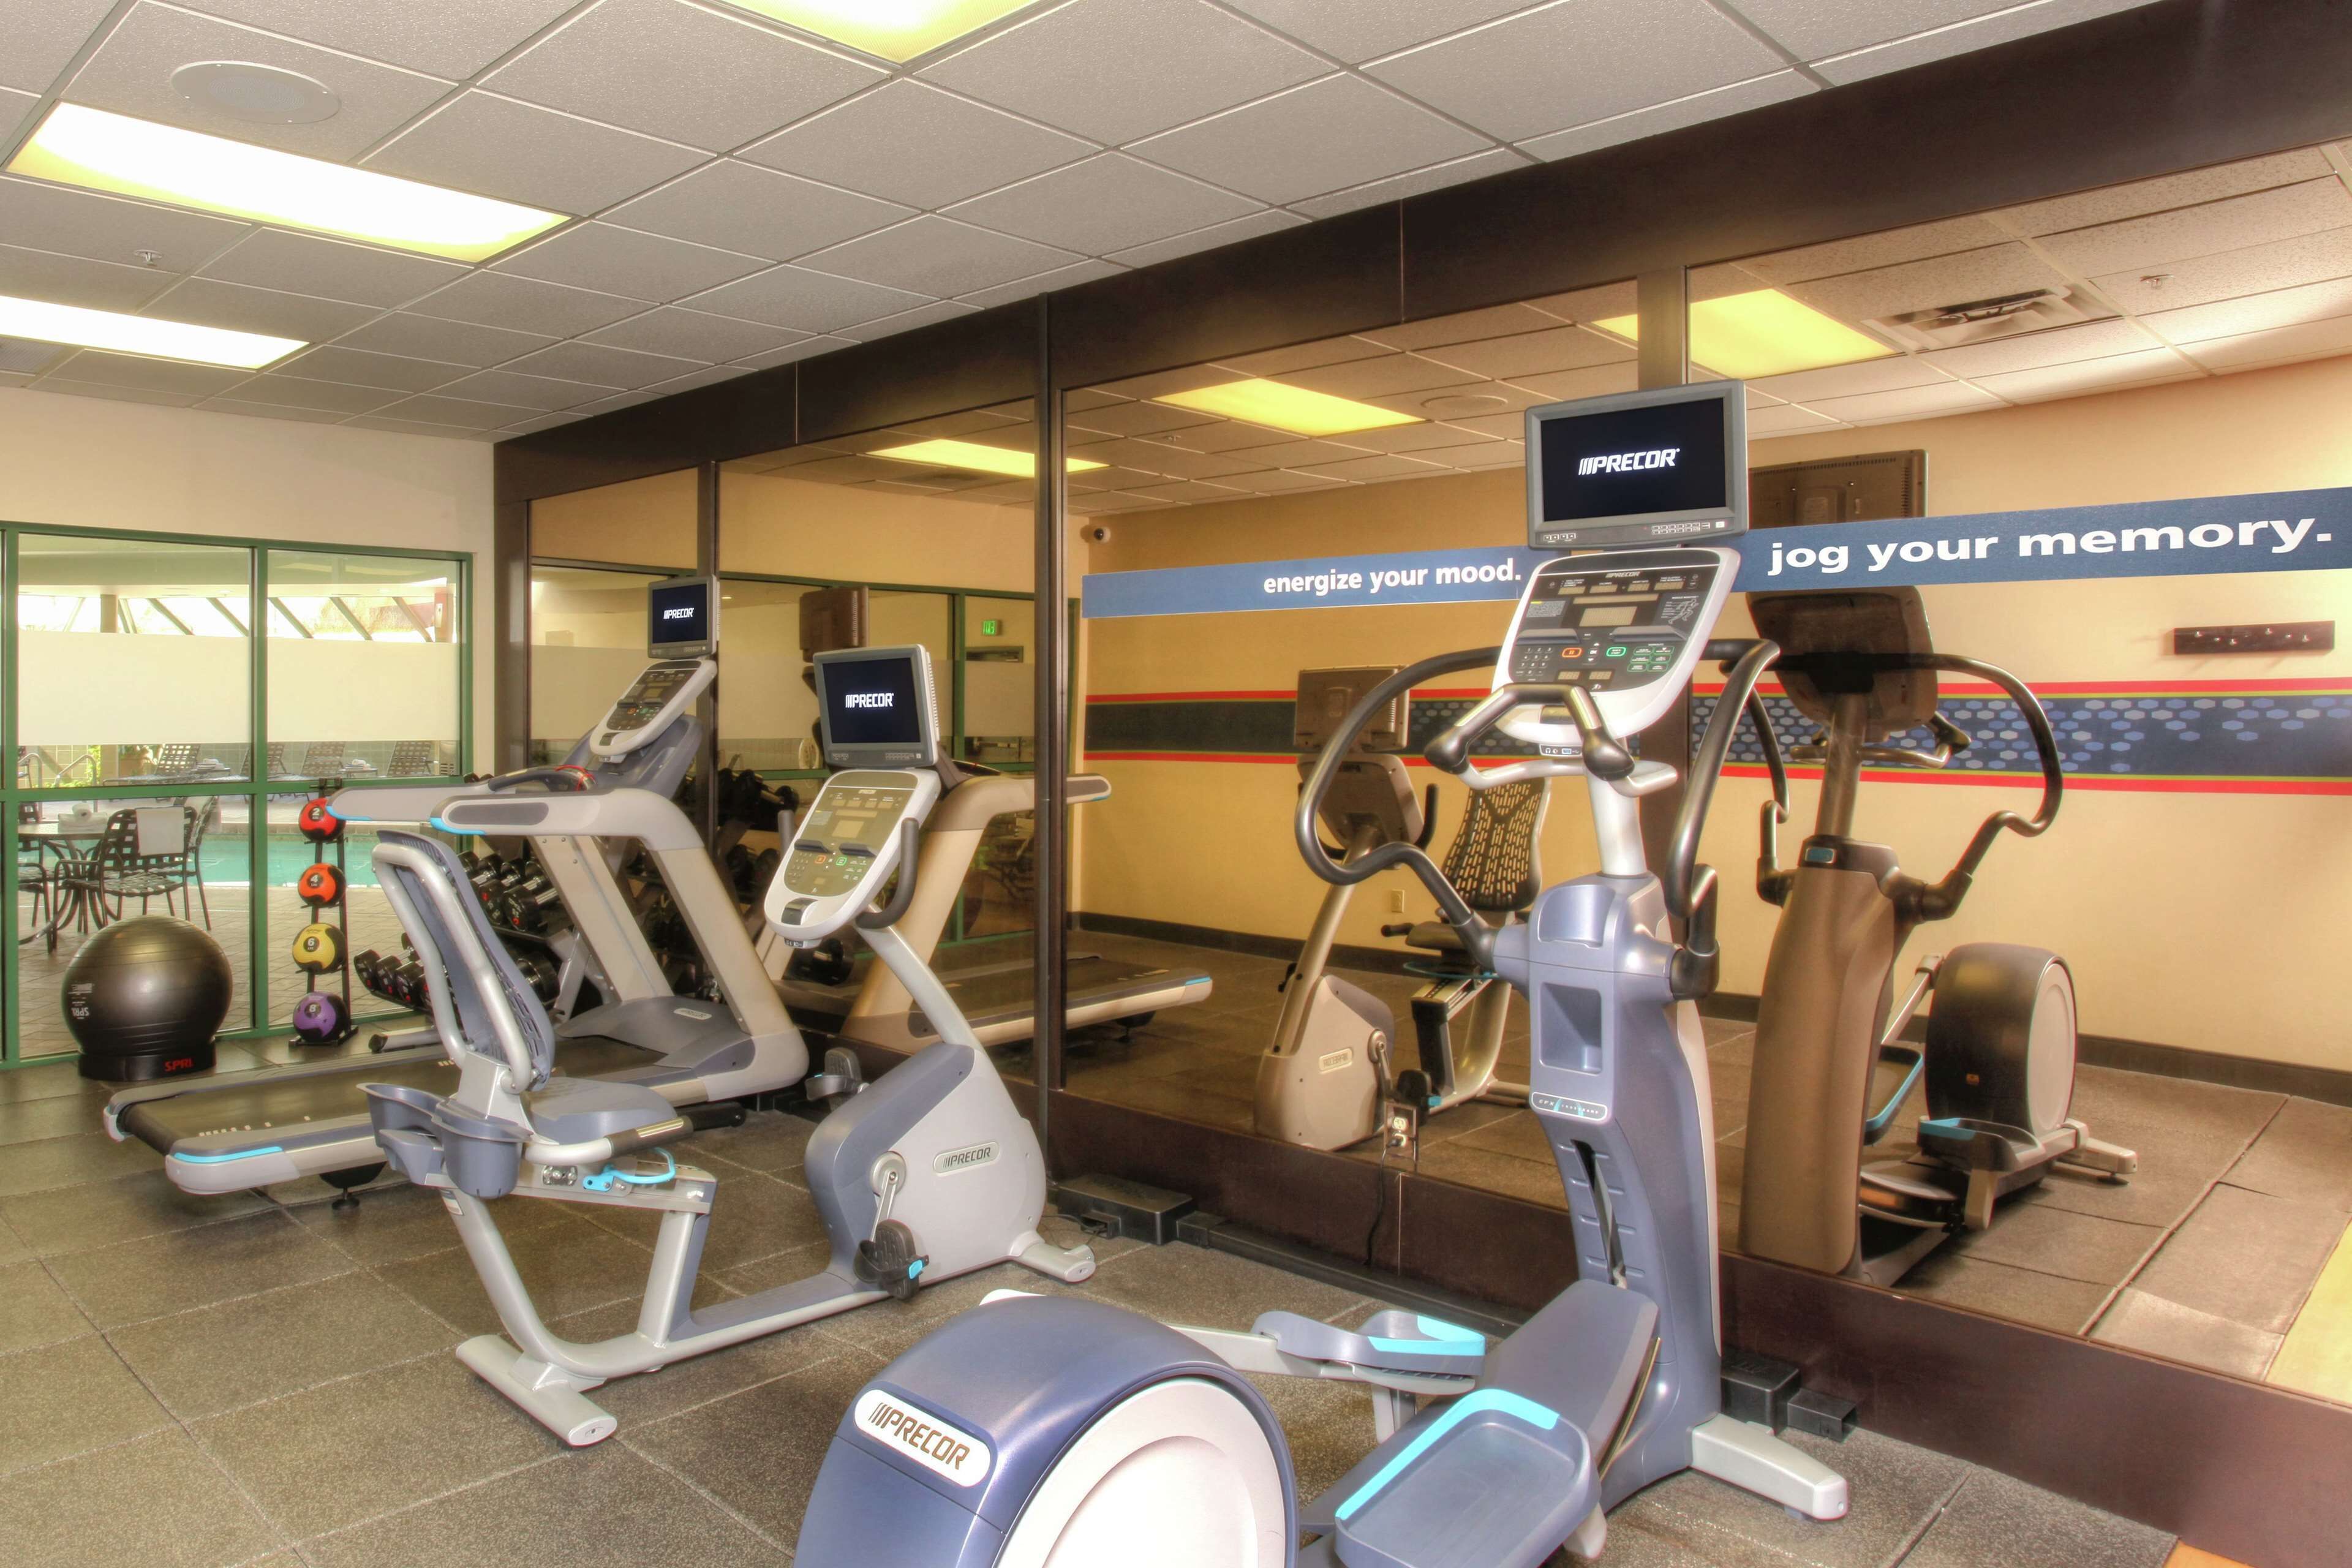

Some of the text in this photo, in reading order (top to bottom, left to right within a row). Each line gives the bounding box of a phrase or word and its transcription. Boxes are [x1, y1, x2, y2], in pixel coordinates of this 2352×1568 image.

[1591, 448, 1676, 475] PRECOR
[1767, 518, 2332, 576] jog your memory.
[1263, 558, 1521, 597] energize your mood.
[667, 608, 693, 619] PRECOR
[852, 693, 893, 708] PRECOR
[312, 807, 320, 816] 2
[310, 874, 318, 883] 4
[307, 938, 315, 946] 6
[309, 1004, 317, 1012] 8
[950, 1147, 991, 1167] PRECOR
[880, 1409, 971, 1471] PRECOR
